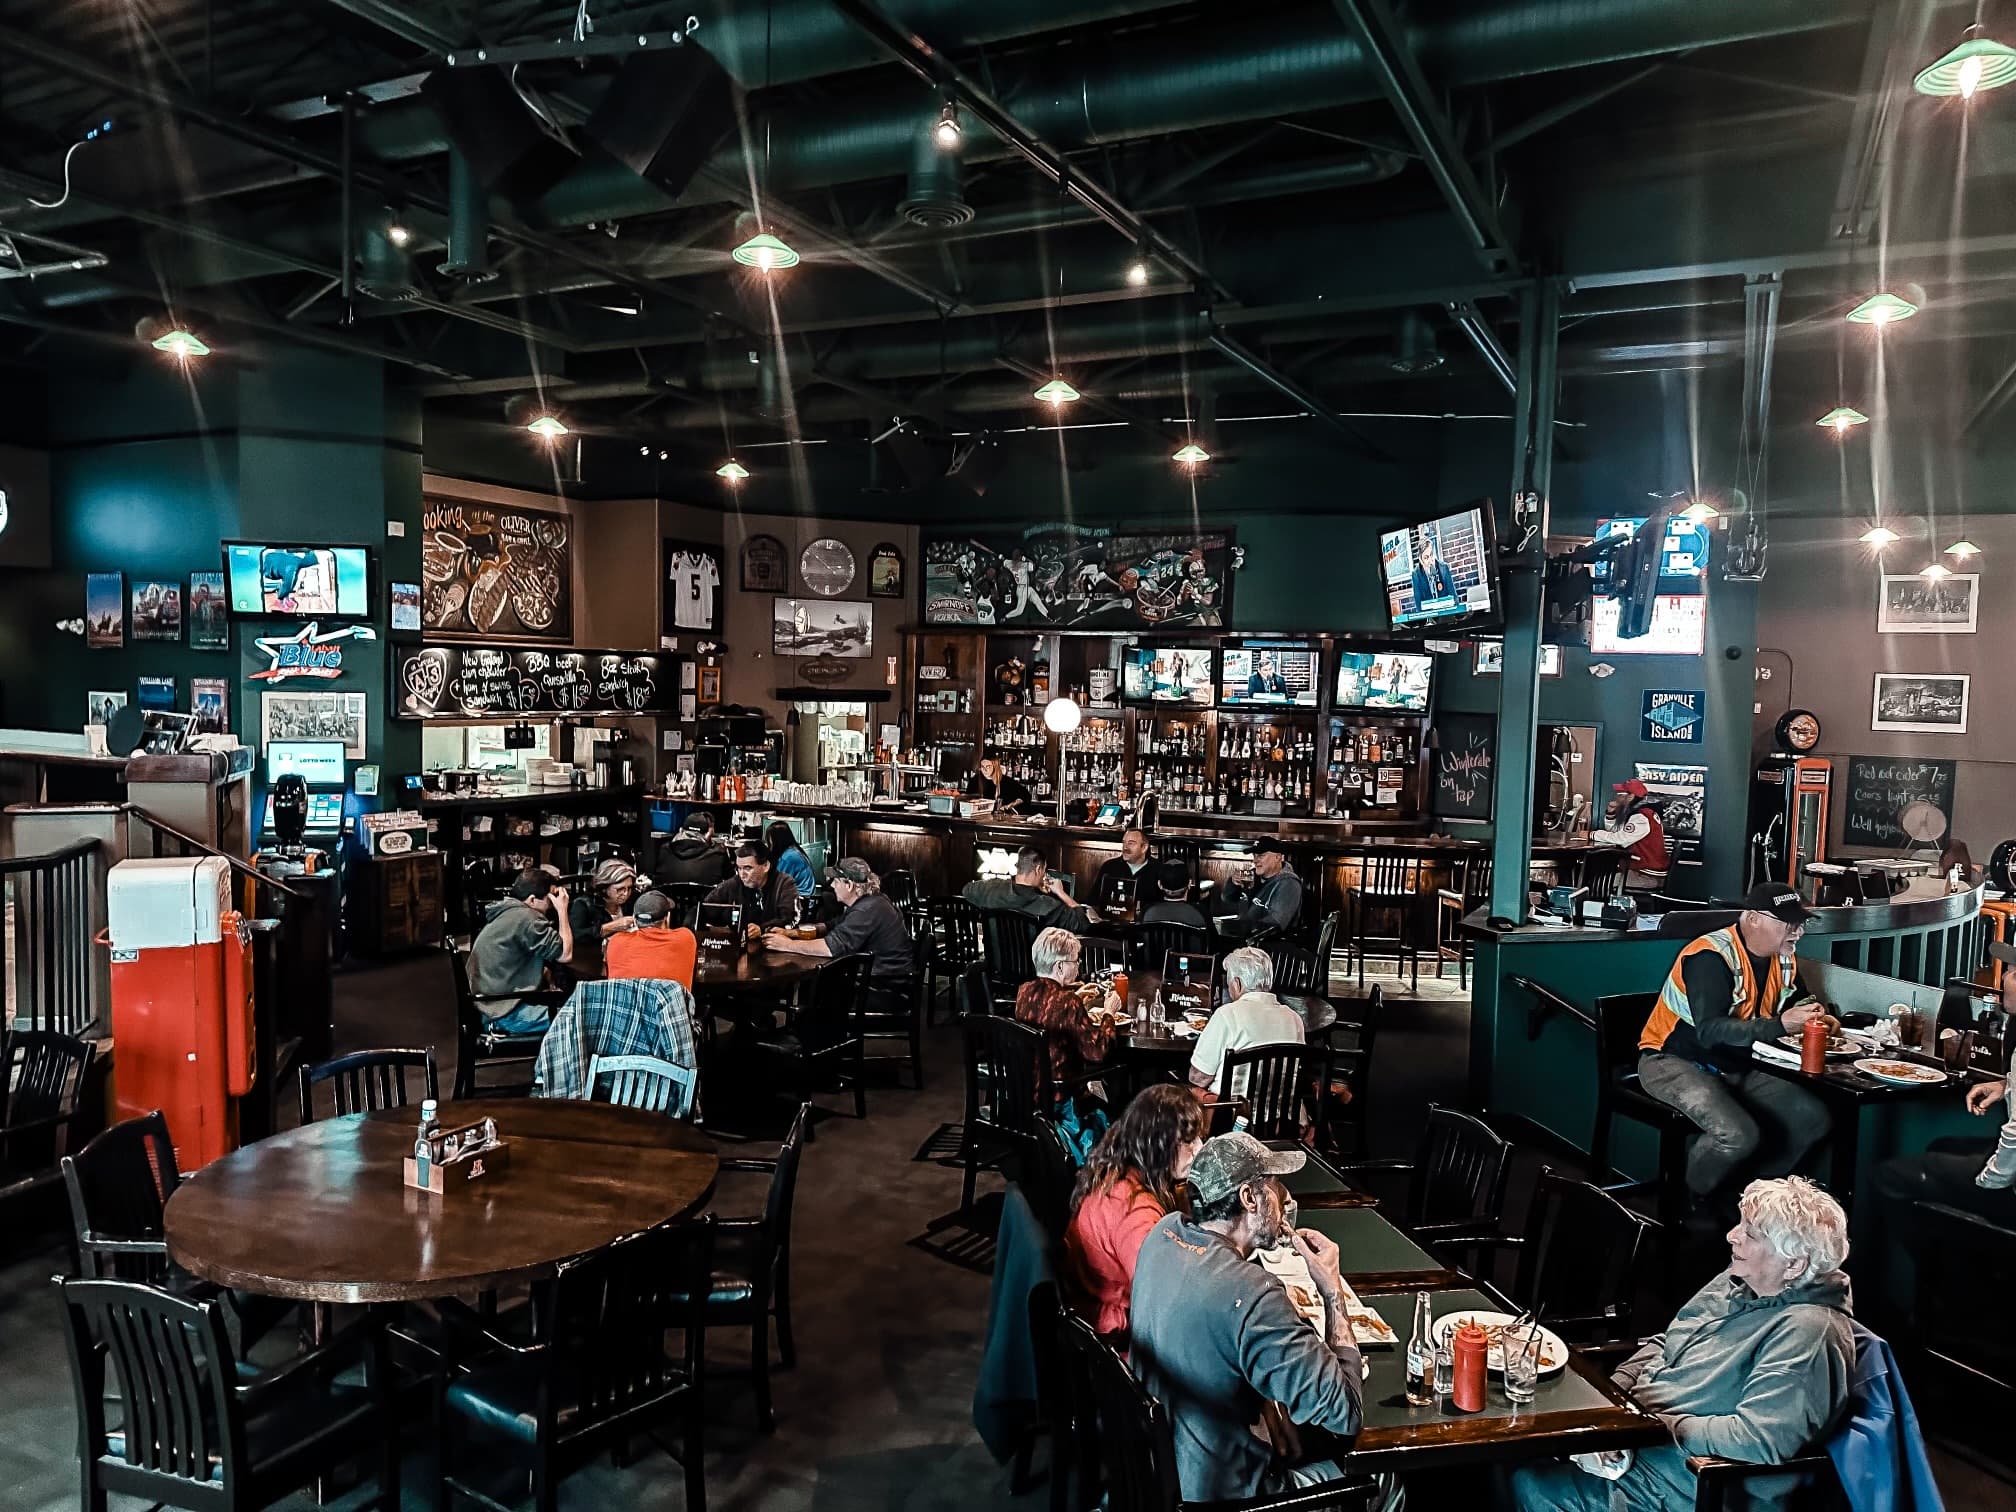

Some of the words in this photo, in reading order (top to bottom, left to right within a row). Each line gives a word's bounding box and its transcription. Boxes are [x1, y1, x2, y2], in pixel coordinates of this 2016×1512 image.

[423, 504, 463, 530] ooking
[500, 515, 531, 534] OLIVER
[826, 540, 833, 550] 12
[1160, 564, 1174, 578] 24
[690, 574, 701, 600] 5
[929, 599, 970, 612] SMIRNOFF
[279, 644, 342, 668] Blue
[463, 651, 479, 666] New
[525, 653, 551, 673] BBQ
[555, 655, 573, 669] beef
[461, 668, 478, 679] clam
[601, 656, 618, 680] 8oz
[463, 680, 478, 695] ham
[598, 675, 629, 694] sandwich
[466, 691, 503, 708] sandwich
[1652, 693, 1696, 710] GRANVILLE
[1650, 722, 1688, 740] ISLAND
[1379, 771, 1388, 781] 19
[1856, 763, 1876, 780] Red
[1896, 766, 1920, 781] cider
[1455, 784, 1475, 806] tap
[1855, 788, 1882, 800] Coors
[1852, 813, 1872, 832] Well
